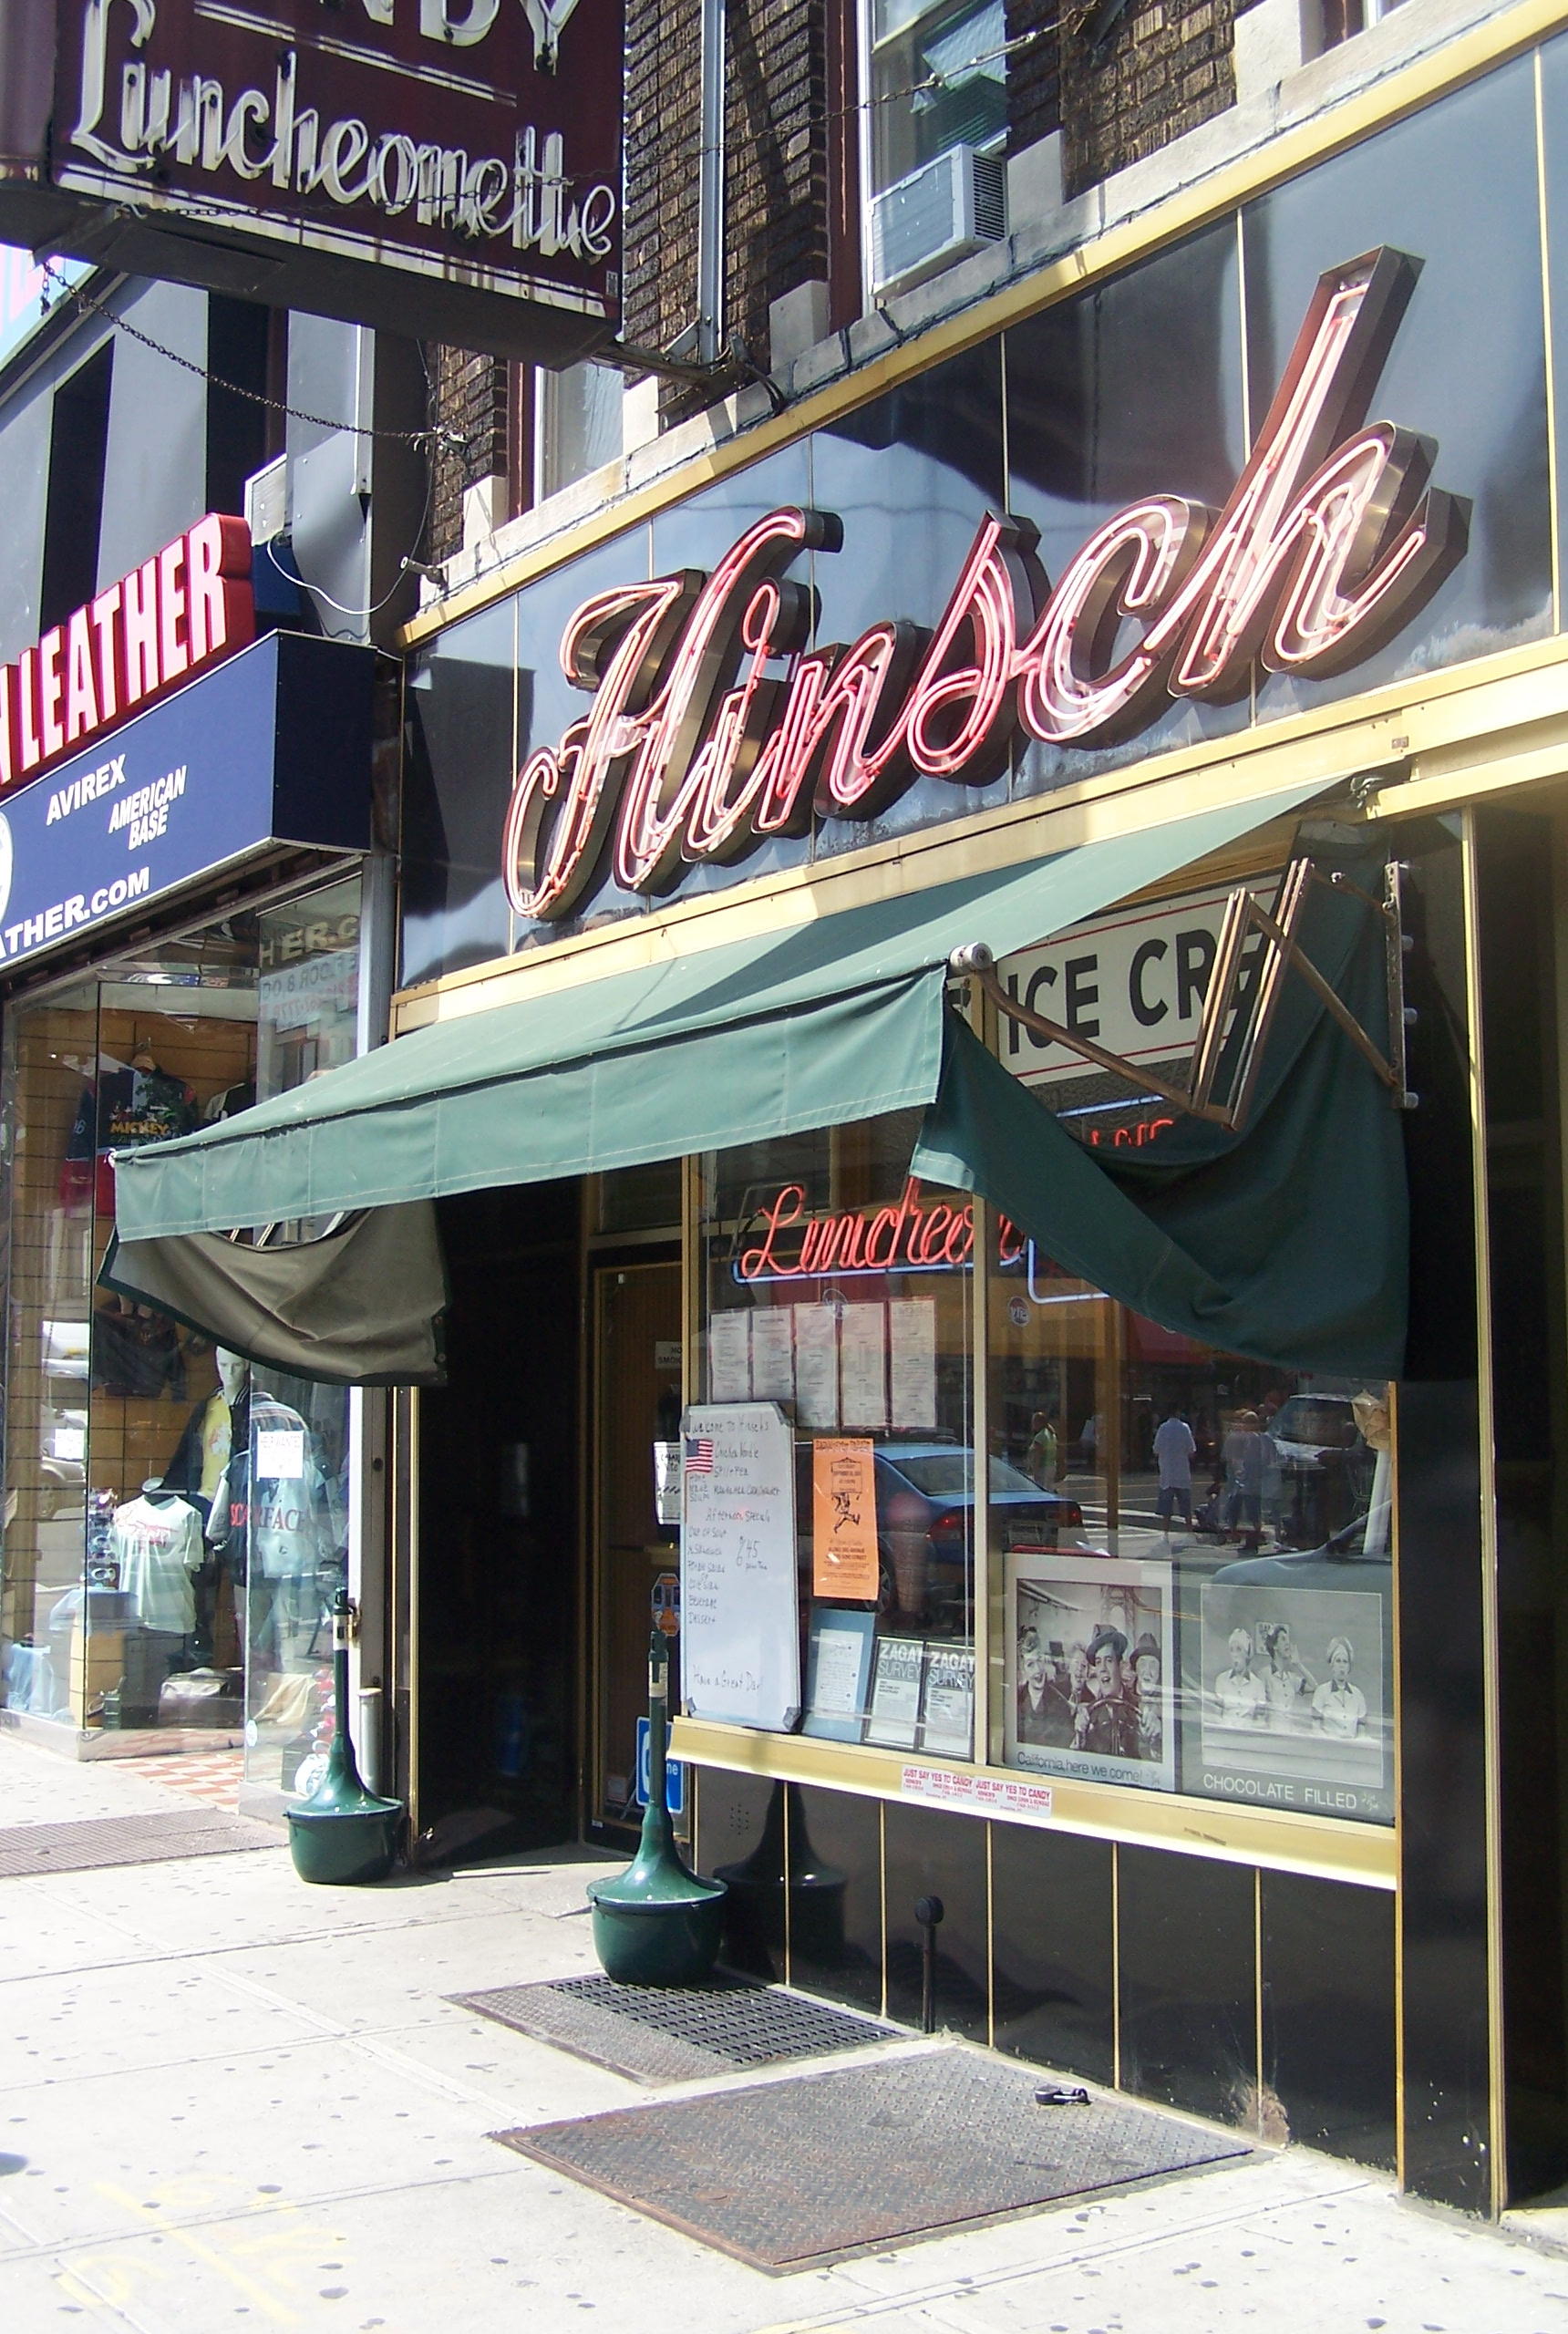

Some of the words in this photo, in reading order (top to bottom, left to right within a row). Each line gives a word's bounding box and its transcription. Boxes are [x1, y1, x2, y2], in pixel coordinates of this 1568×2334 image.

[503, 245, 1463, 921] Hinsch
[20, 512, 227, 772] LEATHER
[46, 753, 126, 826] AVIREX
[108, 765, 188, 834] AMERICAN
[128, 803, 170, 852] BASE
[1007, 954, 1099, 1056] ICE
[109, 1120, 170, 1136] MICKEY
[930, 1650, 975, 1673] ZAGAT
[903, 1768, 918, 1777] JUST
[918, 1770, 930, 1780] SAY
[931, 1772, 943, 1782] YES
[944, 1774, 952, 1783] TO
[952, 1775, 973, 1787] CANDY
[1065, 1758, 1089, 1775] here
[1089, 1764, 1107, 1777] we
[975, 1781, 991, 1791] JUST
[991, 1782, 1004, 1792] SAY
[1005, 1784, 1017, 1795] YES
[1018, 1786, 1027, 1796] TO
[1028, 1788, 1051, 1801] CANDY
[1202, 1772, 1295, 1802] CHOCOLATE
[1304, 1787, 1357, 1810] FILLED
